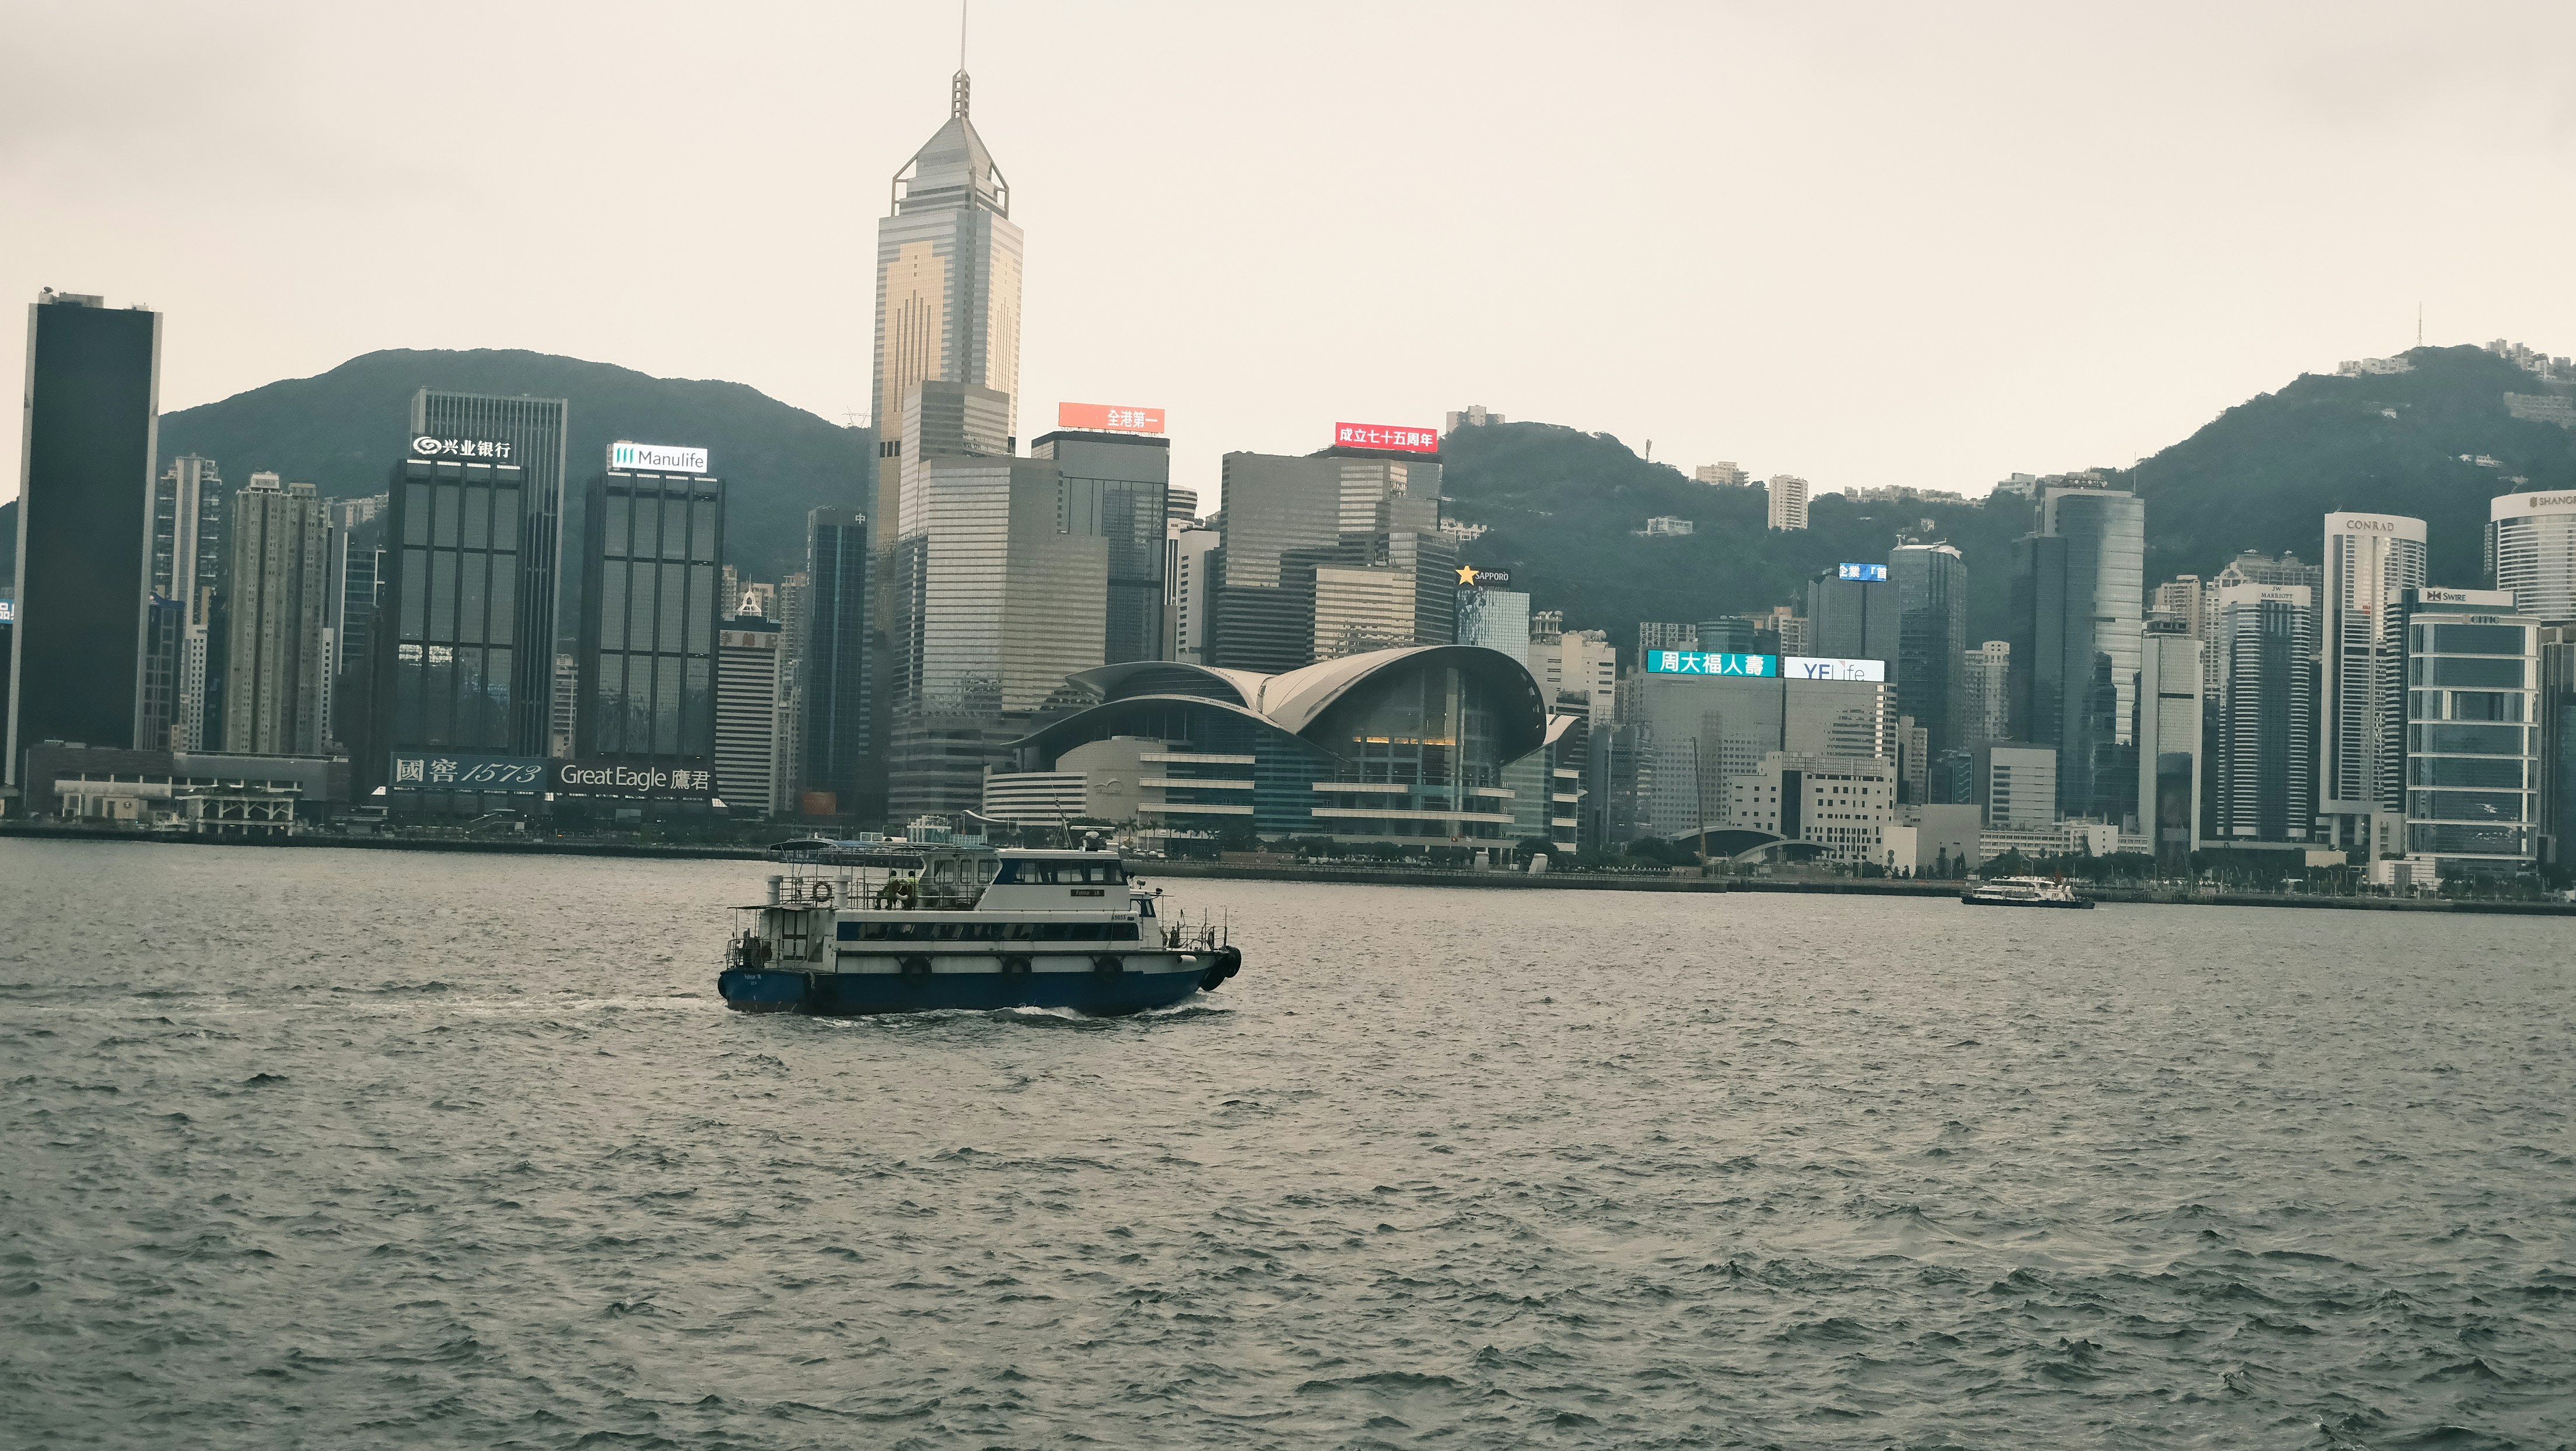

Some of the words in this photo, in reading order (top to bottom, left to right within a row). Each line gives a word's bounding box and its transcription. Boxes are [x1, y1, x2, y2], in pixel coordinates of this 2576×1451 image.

[1107, 409, 1158, 428] 全港第一
[1340, 427, 1433, 447] 成立七十五周年
[442, 439, 511, 458] 兴业银行
[639, 450, 704, 468] Manulife
[2347, 520, 2394, 531] CONRAD
[1475, 572, 1509, 581] SAPPORO
[2471, 615, 2500, 624] CITIC
[1660, 651, 1764, 676] 周大福人壽
[396, 759, 458, 783] 國窖
[461, 763, 542, 783] 1573
[561, 765, 613, 786] Great
[616, 766, 667, 791] Eagle
[670, 769, 711, 790] 鷹君
